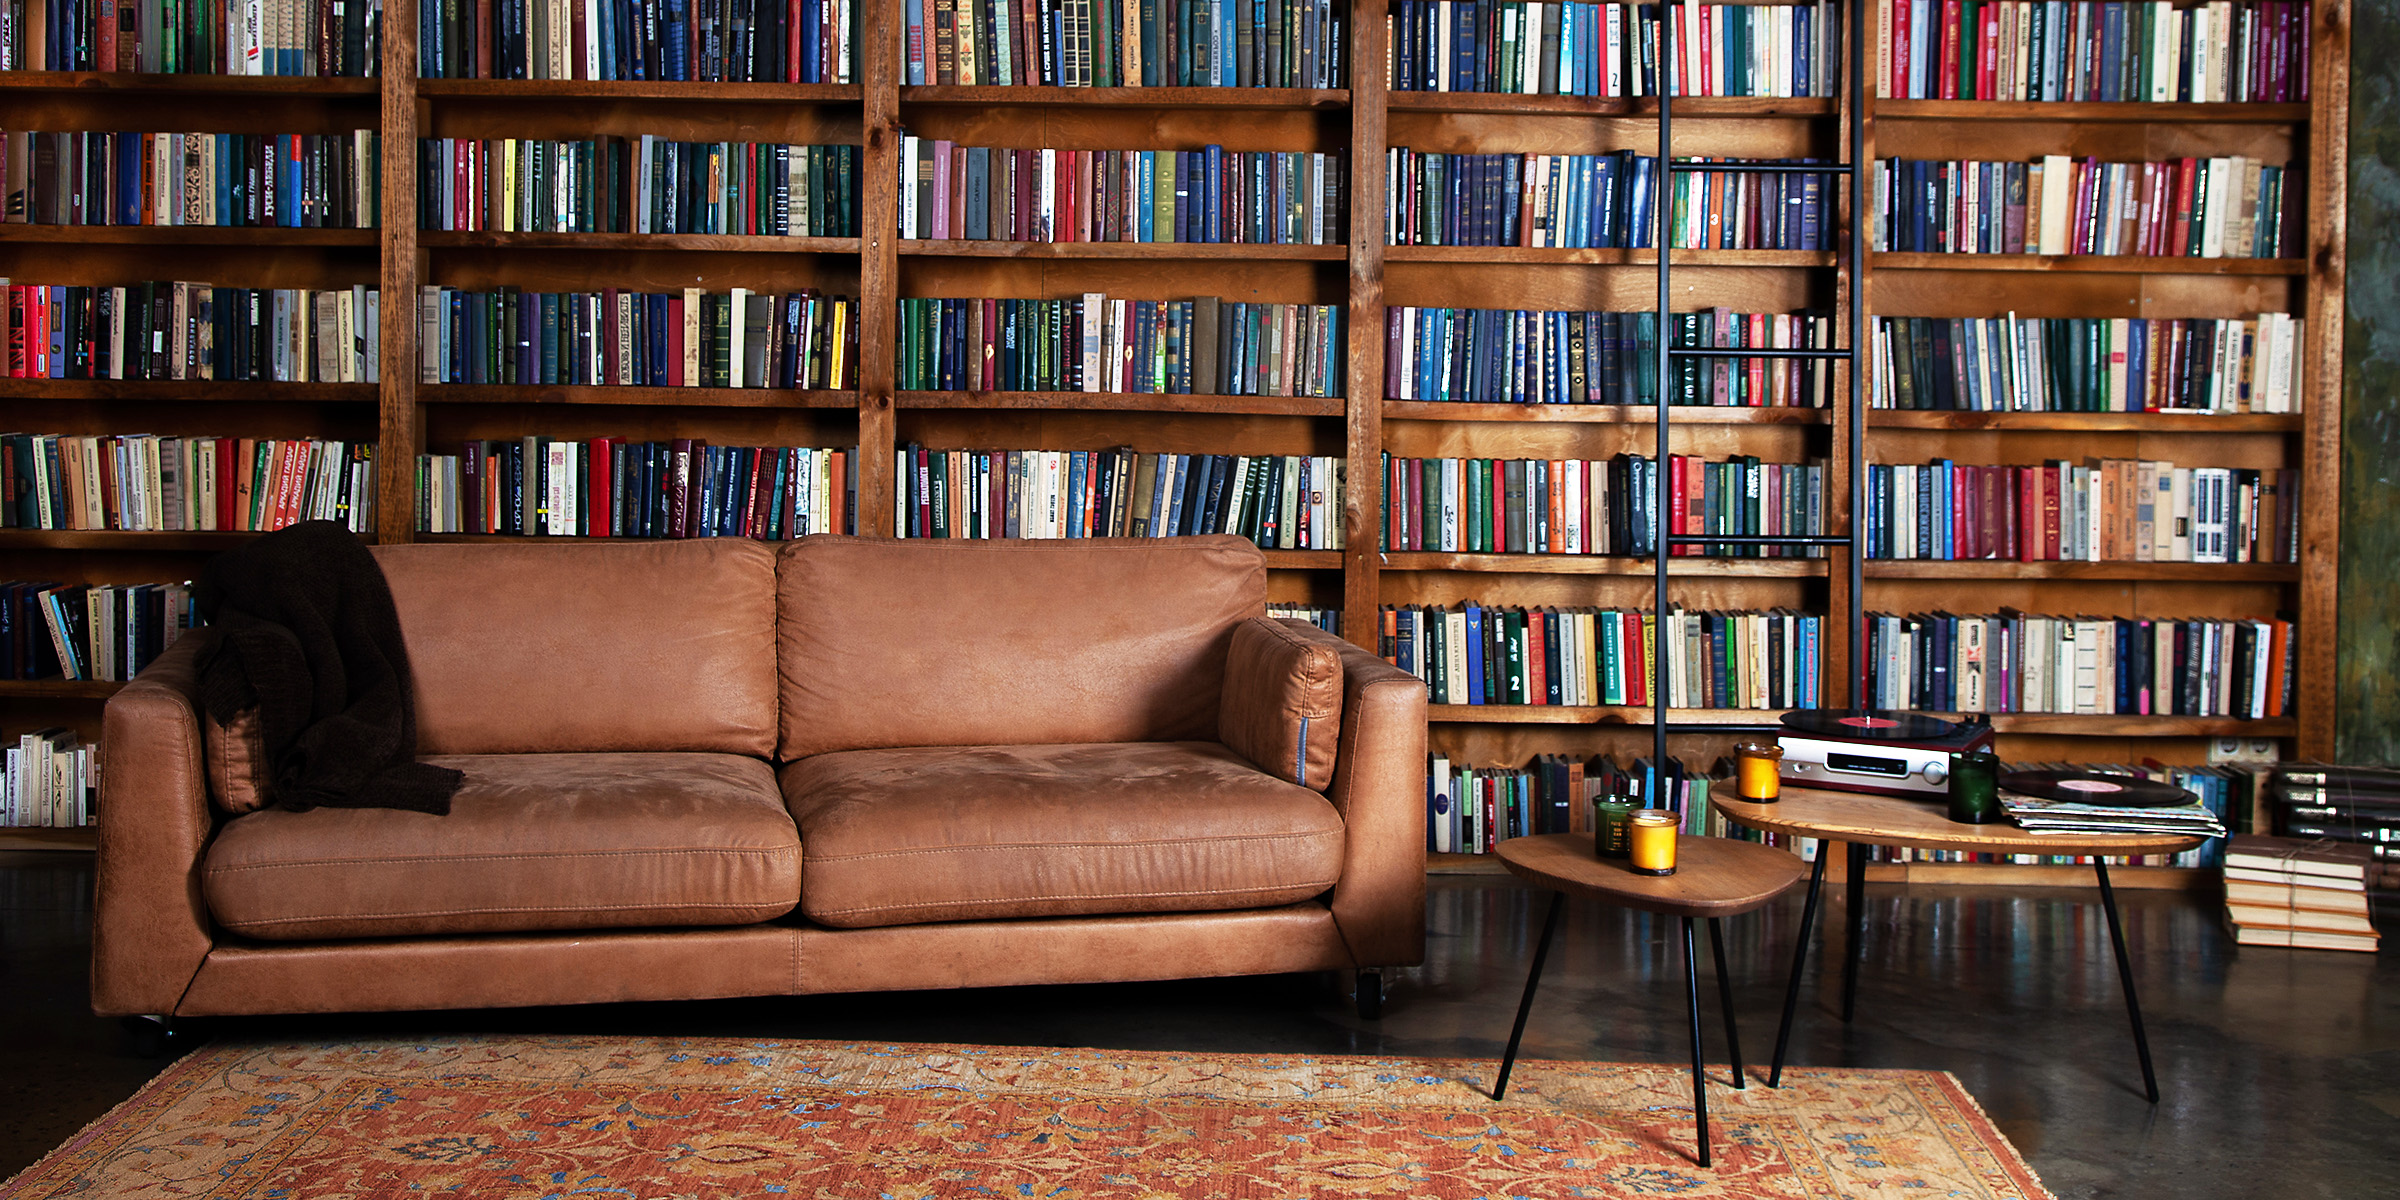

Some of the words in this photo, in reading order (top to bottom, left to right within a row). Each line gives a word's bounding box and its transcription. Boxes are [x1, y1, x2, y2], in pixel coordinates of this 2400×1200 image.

[1612, 73, 1618, 87] 2
[264, 145, 274, 216] ГУСИ-ЛЕБЕДИ
[619, 296, 630, 342] НЕНАВИСТЬ
[620, 342, 629, 350] И
[620, 351, 630, 383] ЛЮБОВЬ
[278, 475, 290, 509] АРКАДИЙ
[284, 446, 293, 474] ГАЙДАР
[291, 475, 302, 509] АРКАДИЙ
[297, 446, 307, 474] ГАЙДАР
[276, 517, 283, 526] 2
[288, 517, 294, 526] 3
[1511, 676, 1519, 691] 2
[1551, 685, 1559, 695] 3
